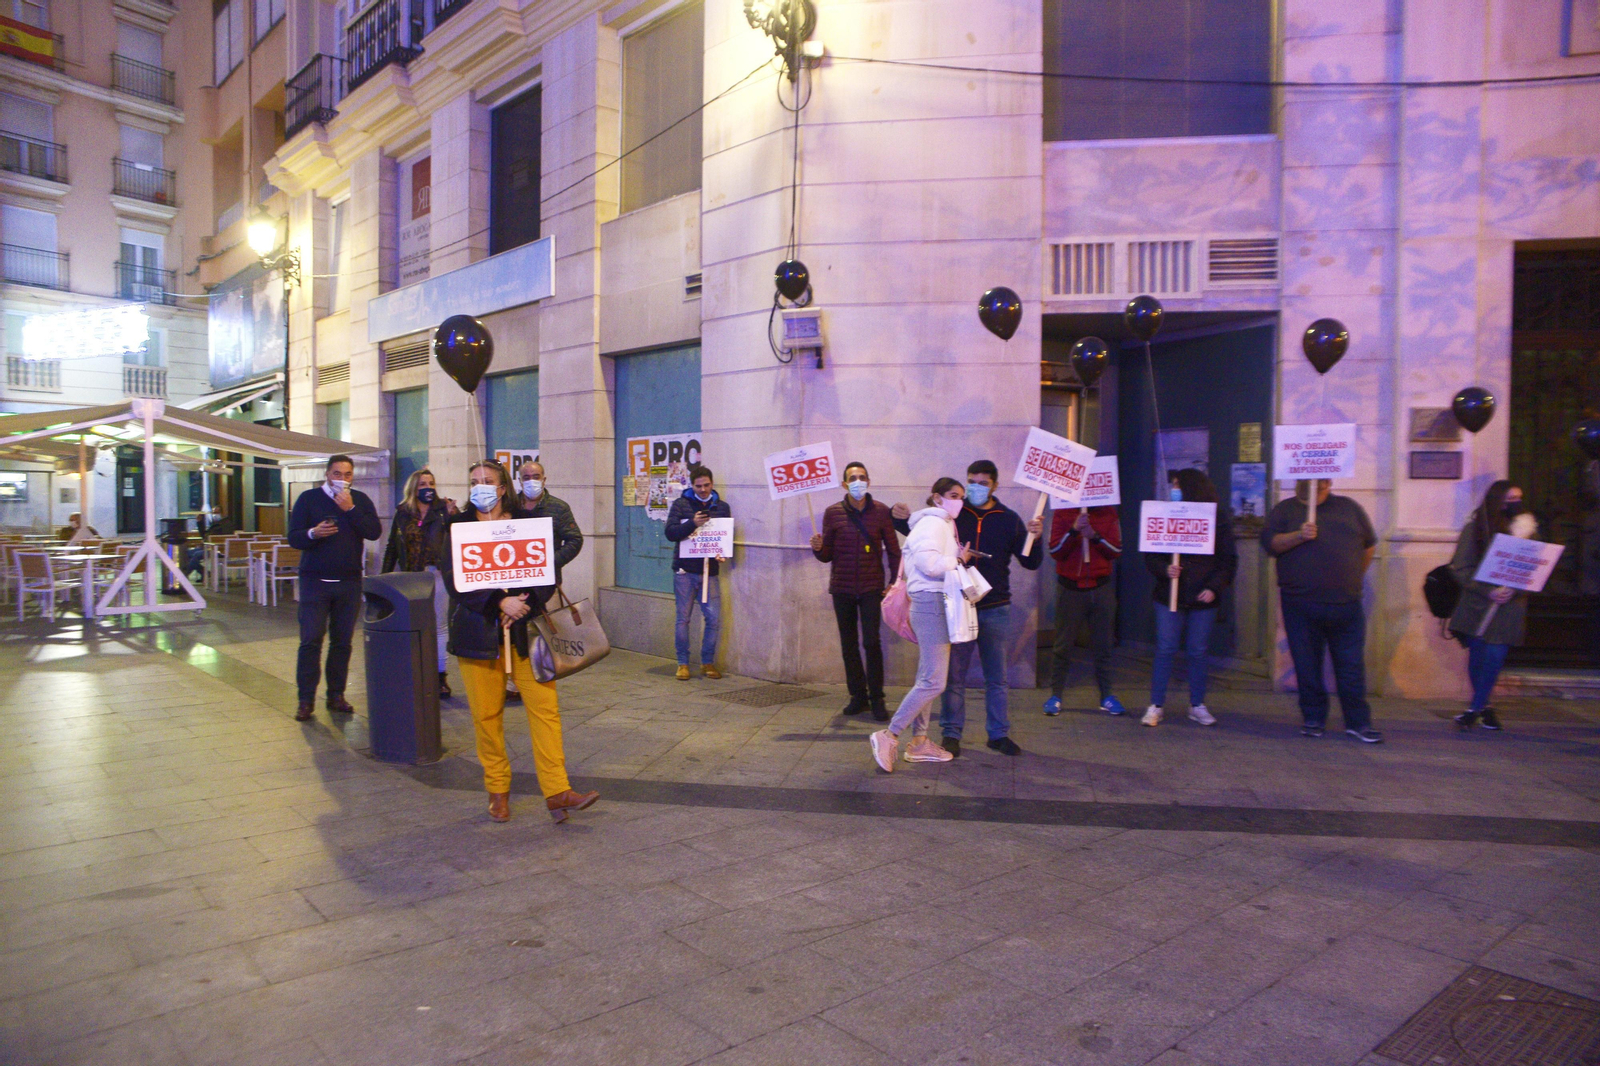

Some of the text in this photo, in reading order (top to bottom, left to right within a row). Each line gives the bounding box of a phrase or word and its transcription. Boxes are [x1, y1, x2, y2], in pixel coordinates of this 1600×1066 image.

[1305, 442, 1347, 450] OBLIGAIS
[773, 458, 829, 484] S.O.S
[1026, 448, 1085, 481] SE TRASPASA
[777, 477, 831, 493] HOSTELERIA
[1023, 464, 1080, 490] OCIO NOCTURNO
[1148, 518, 1209, 534] SE VENDE
[463, 541, 545, 570] S.O.S
[465, 568, 545, 583] HOSTELERIA
[551, 636, 585, 657] GUESS
